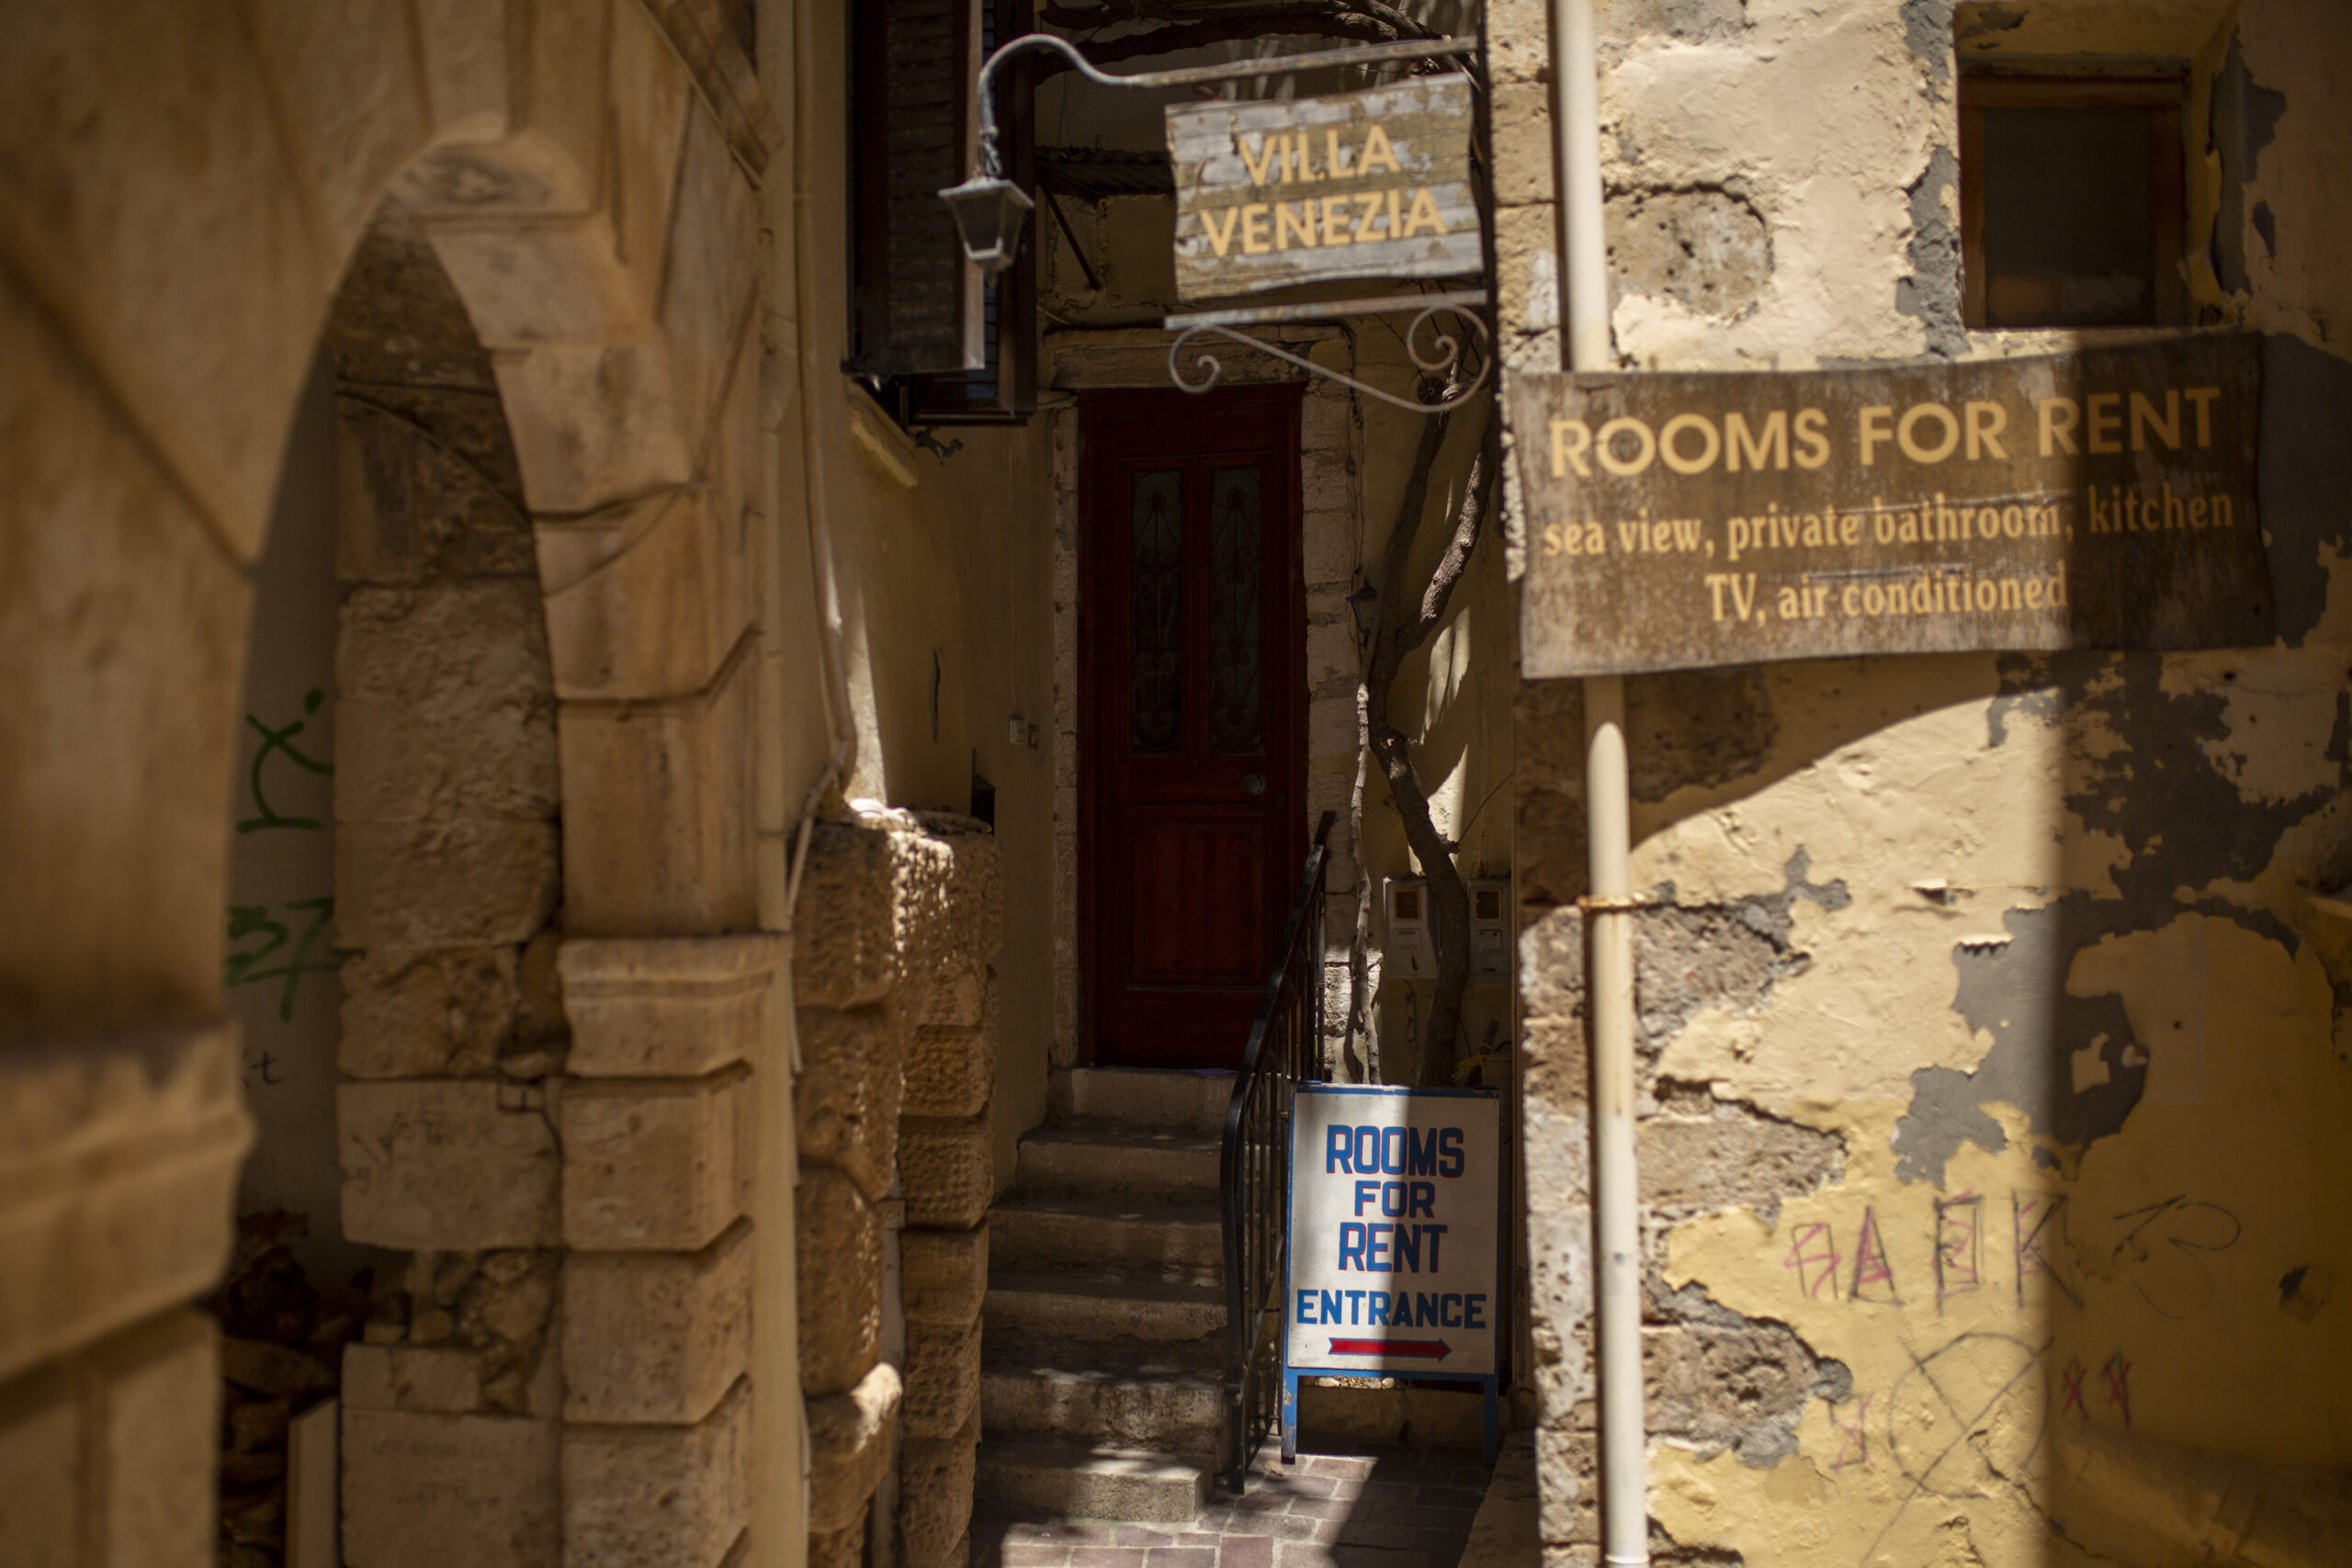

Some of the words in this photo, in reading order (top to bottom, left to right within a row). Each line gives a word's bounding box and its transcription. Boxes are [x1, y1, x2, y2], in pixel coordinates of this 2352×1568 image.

[1238, 124, 1402, 186] VILLA
[1198, 186, 1449, 258] VENEZIA
[1548, 407, 1831, 479] ROOMS
[1858, 400, 2010, 467] FOR
[2038, 386, 2221, 457] RENT
[1543, 521, 1607, 557] sea
[1618, 506, 1715, 558] view,
[1727, 502, 1860, 562] private
[1872, 491, 2075, 547] bathroom,
[2087, 480, 2234, 536] kitchen
[1703, 571, 1767, 628] TV,
[1777, 571, 1830, 621] air
[1841, 558, 2069, 618] conditioned
[1325, 1123, 1465, 1179] ROOMS
[1354, 1179, 1436, 1219] FOR
[1338, 1221, 1449, 1274] RENT
[1295, 1288, 1487, 1330] ENTRANCE
